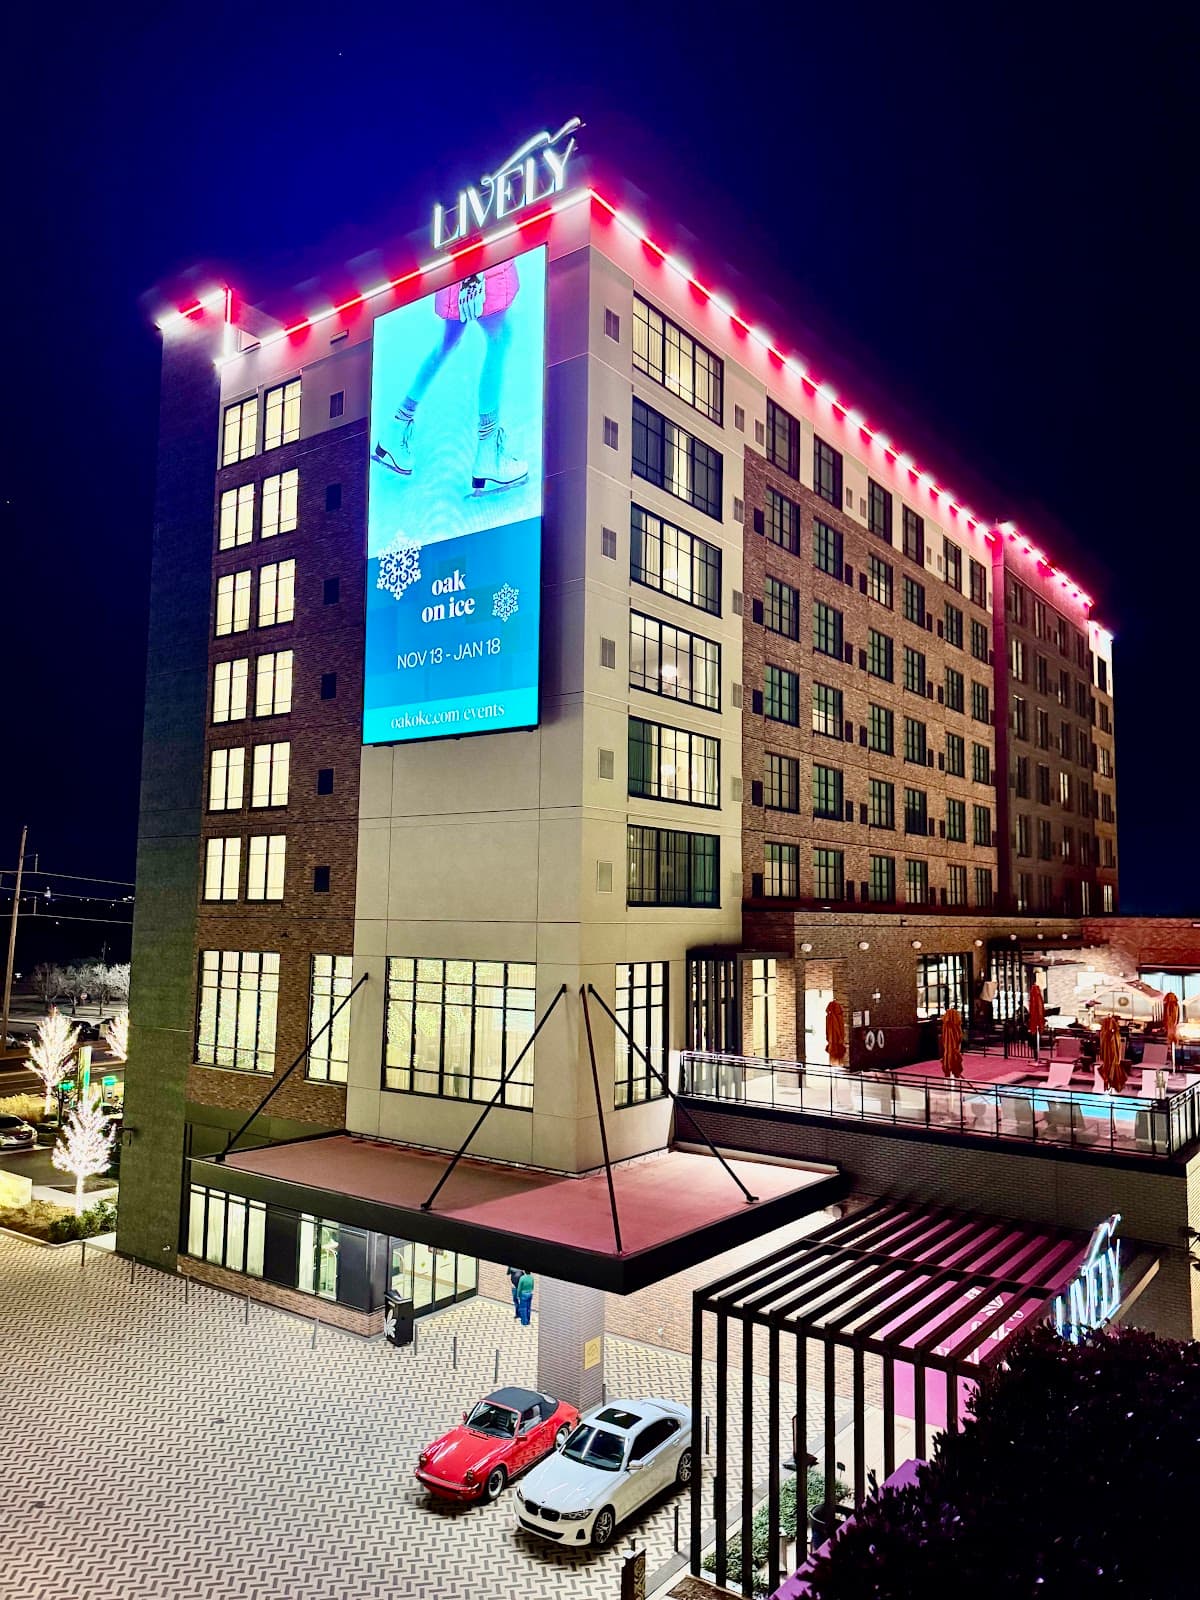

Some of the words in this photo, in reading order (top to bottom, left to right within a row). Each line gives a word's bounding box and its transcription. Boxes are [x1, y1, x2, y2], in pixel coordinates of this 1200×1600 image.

[434, 117, 582, 248] LIVELY
[432, 569, 466, 596] oak
[422, 606, 445, 623] on
[449, 597, 475, 620] ice
[397, 649, 428, 669] NOV
[430, 647, 443, 665] 13
[453, 640, 483, 661] JAN
[486, 638, 501, 655] 18
[391, 709, 460, 729] oakokc.com
[463, 703, 505, 720] events
